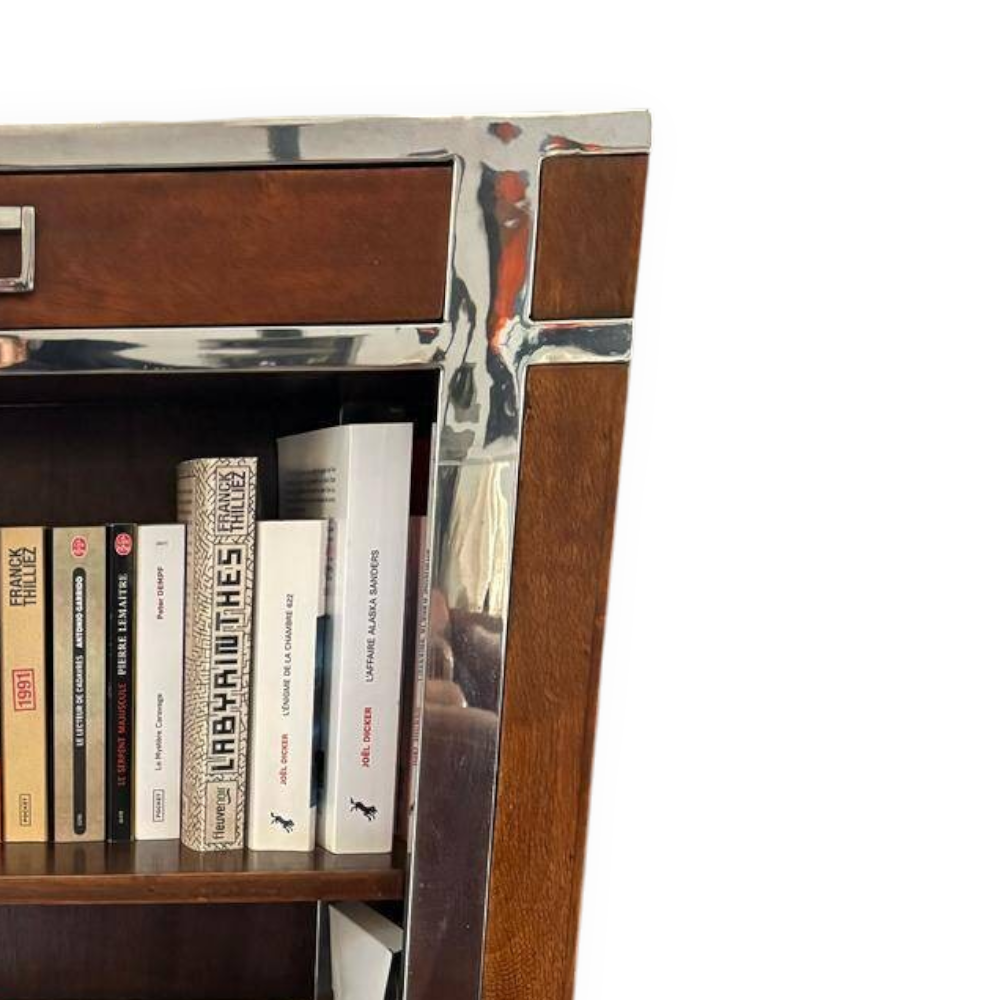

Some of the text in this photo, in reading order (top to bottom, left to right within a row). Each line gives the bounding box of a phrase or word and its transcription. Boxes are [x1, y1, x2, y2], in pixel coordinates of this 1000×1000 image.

[217, 471, 230, 533] FRANCK
[231, 470, 246, 532] THILLIEZ
[9, 547, 23, 607] FRANCK
[23, 546, 37, 606] THILLIEZ
[156, 566, 164, 620] Peter DEMPF
[75, 612, 83, 648] ANTONIO
[365, 549, 380, 682] L'AFFAIRE ALASKA SANDERS
[118, 635, 127, 676] PIERRE
[211, 547, 242, 772] LABYRINTHES
[282, 593, 294, 716] L'ÉNIGME DE LA CHAMBRE 622
[16, 671, 33, 708] 1991
[118, 682, 127, 735] MAJUSCULE
[75, 707, 84, 736] LECTEUR
[75, 737, 84, 747] LE
[361, 706, 373, 769] JOËL DICKER
[118, 737, 127, 773] SERPENT
[280, 733, 289, 786] JOËL DICKER
